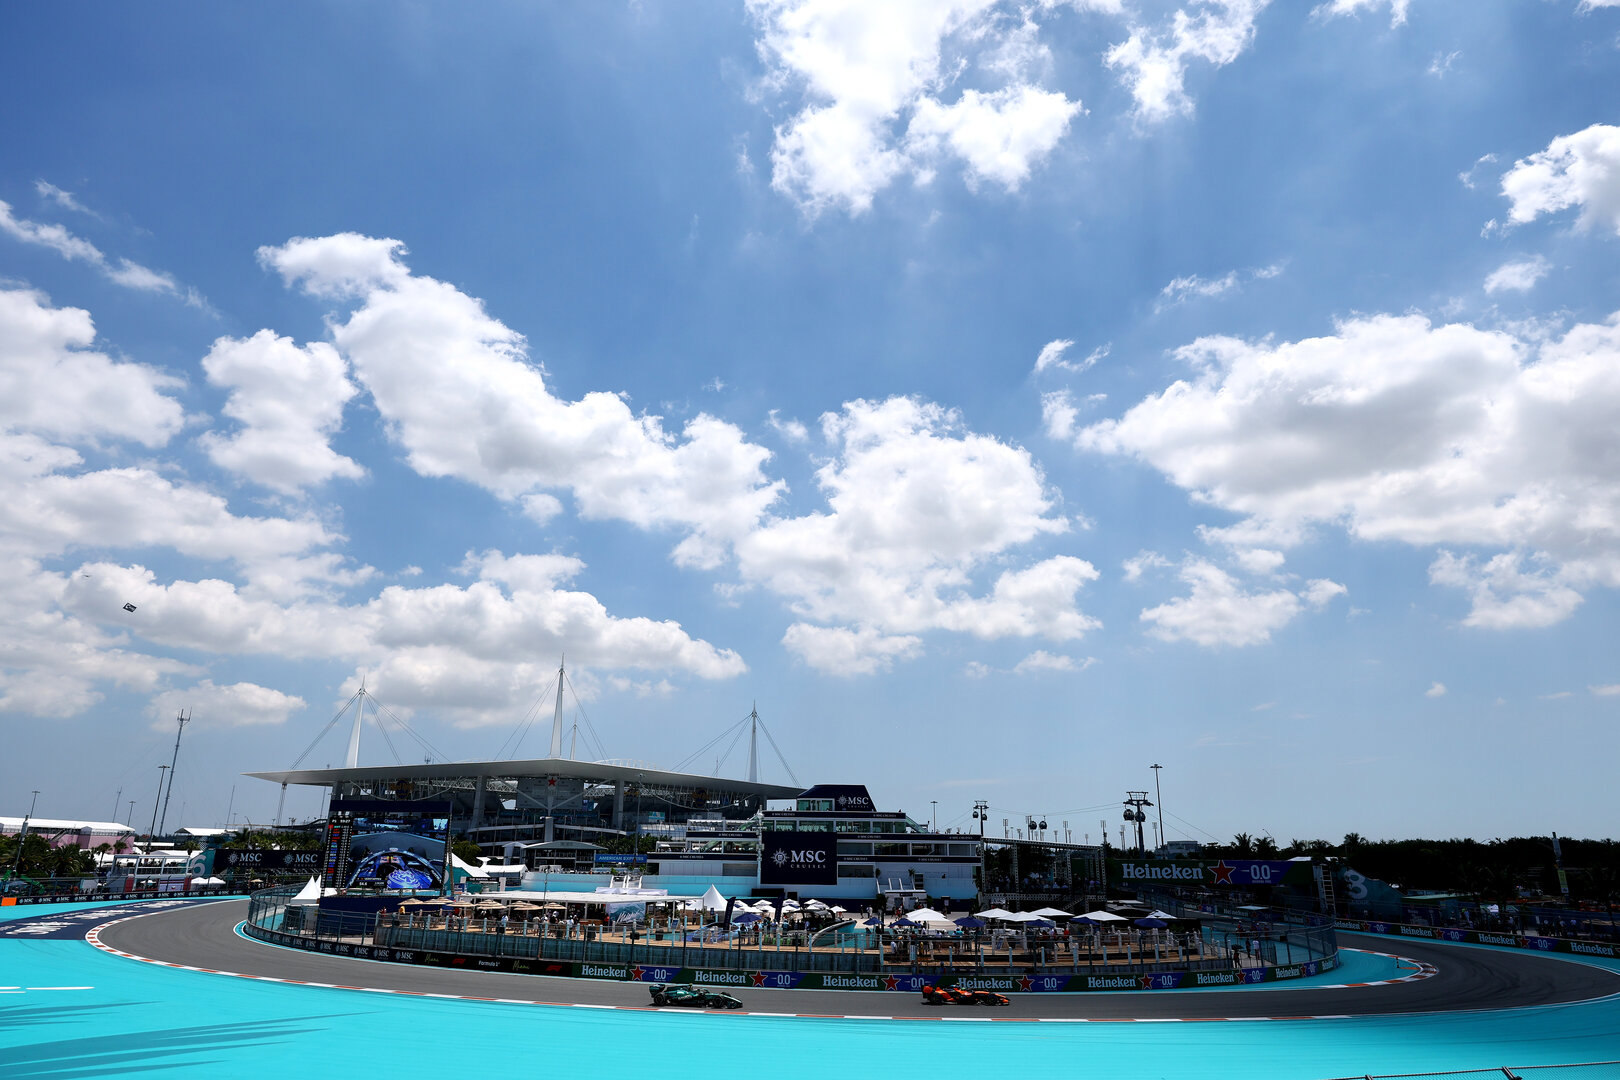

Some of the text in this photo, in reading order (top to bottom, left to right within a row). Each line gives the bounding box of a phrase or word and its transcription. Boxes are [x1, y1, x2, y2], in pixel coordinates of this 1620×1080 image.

[848, 796, 869, 804] MSC
[240, 853, 262, 862] MSC
[295, 854, 318, 863] MSC
[790, 850, 826, 863] MSC
[191, 854, 206, 876] 6
[1122, 863, 1270, 879] Heineken 0.0
[1400, 926, 1432, 937] Heineken
[1478, 933, 1515, 944] Heineken
[379, 949, 389, 957] MSC
[1570, 942, 1614, 956] Heineken
[581, 965, 627, 978] Heineken
[694, 971, 746, 984] Heineken
[823, 976, 878, 987] Heineken
[958, 978, 1013, 988] Heineken
[1088, 977, 1136, 988] Heineken
[1197, 973, 1234, 984] Heineken
